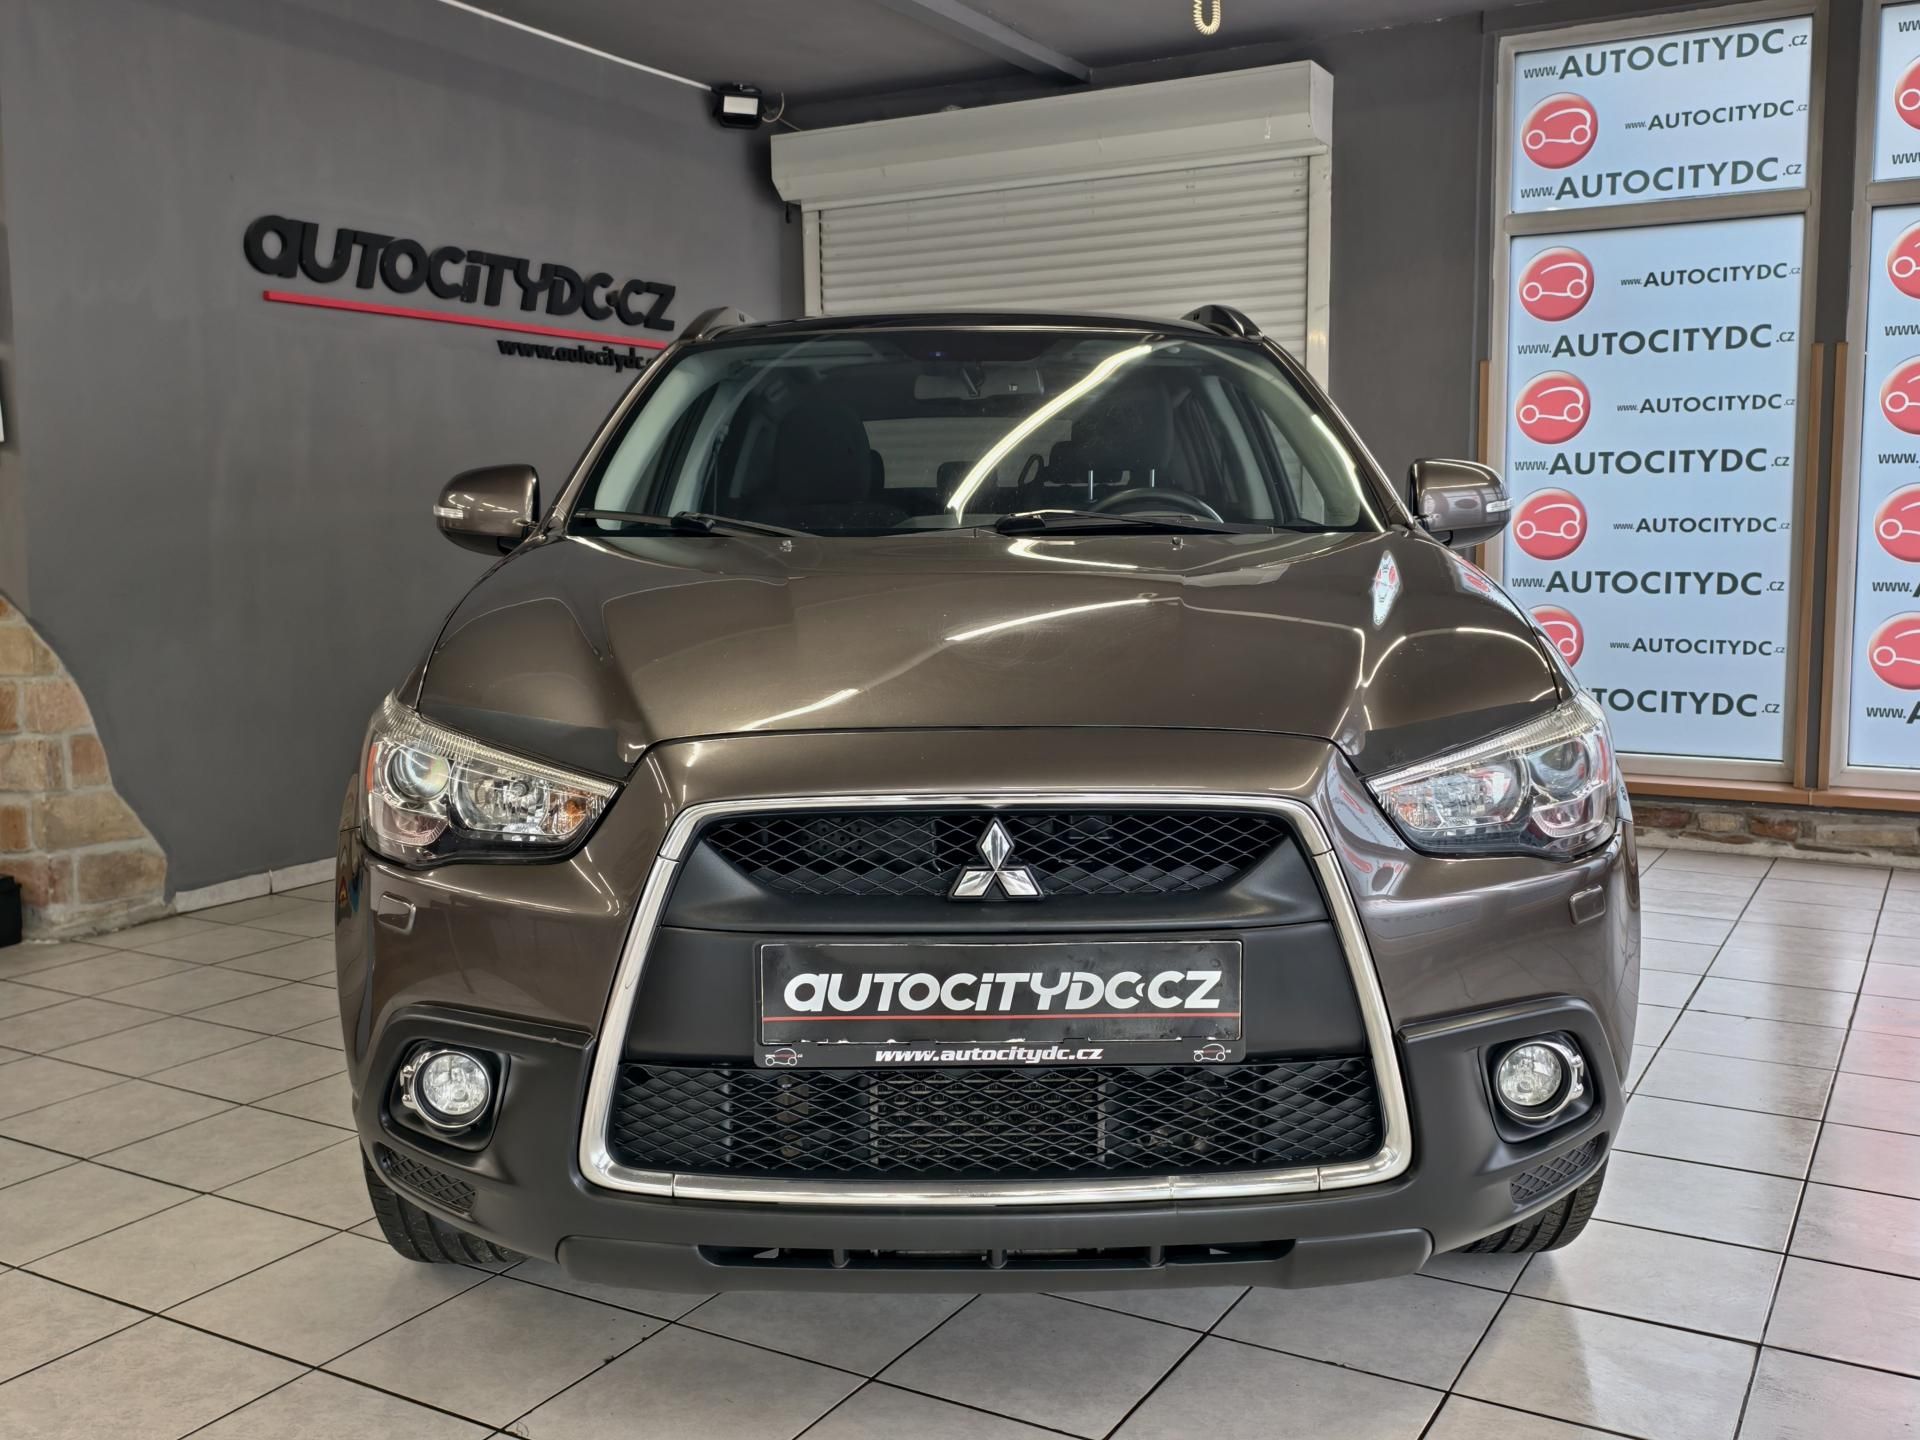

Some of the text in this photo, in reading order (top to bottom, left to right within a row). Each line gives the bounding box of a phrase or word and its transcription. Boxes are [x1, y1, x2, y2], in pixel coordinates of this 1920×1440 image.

[1523, 28, 1808, 80] www.AUTOCITYDC.cz
[1624, 99, 1808, 131] www.AUTOCITYDC.cz
[1520, 157, 1802, 200] www.AUTOCITYDC.cz
[1620, 262, 1800, 288] www.AUTOCITYDC.cz
[1517, 323, 1795, 359] www.AUTOCITYDC.cz
[1616, 393, 1795, 414] www.AUTOCITYDC.cz
[1514, 447, 1790, 476] www.AUTOCITYDC.cz
[1612, 516, 1790, 534] www.AUTOCITYDC.cz
[1511, 570, 1785, 596] www.AUTOCITYDC.cz
[1609, 637, 1785, 657] www.AUTOCITYDC.cz
[1587, 687, 1781, 718] TOCITYDC.cz
[875, 1045, 1103, 1064] www.autocitydc.cz
